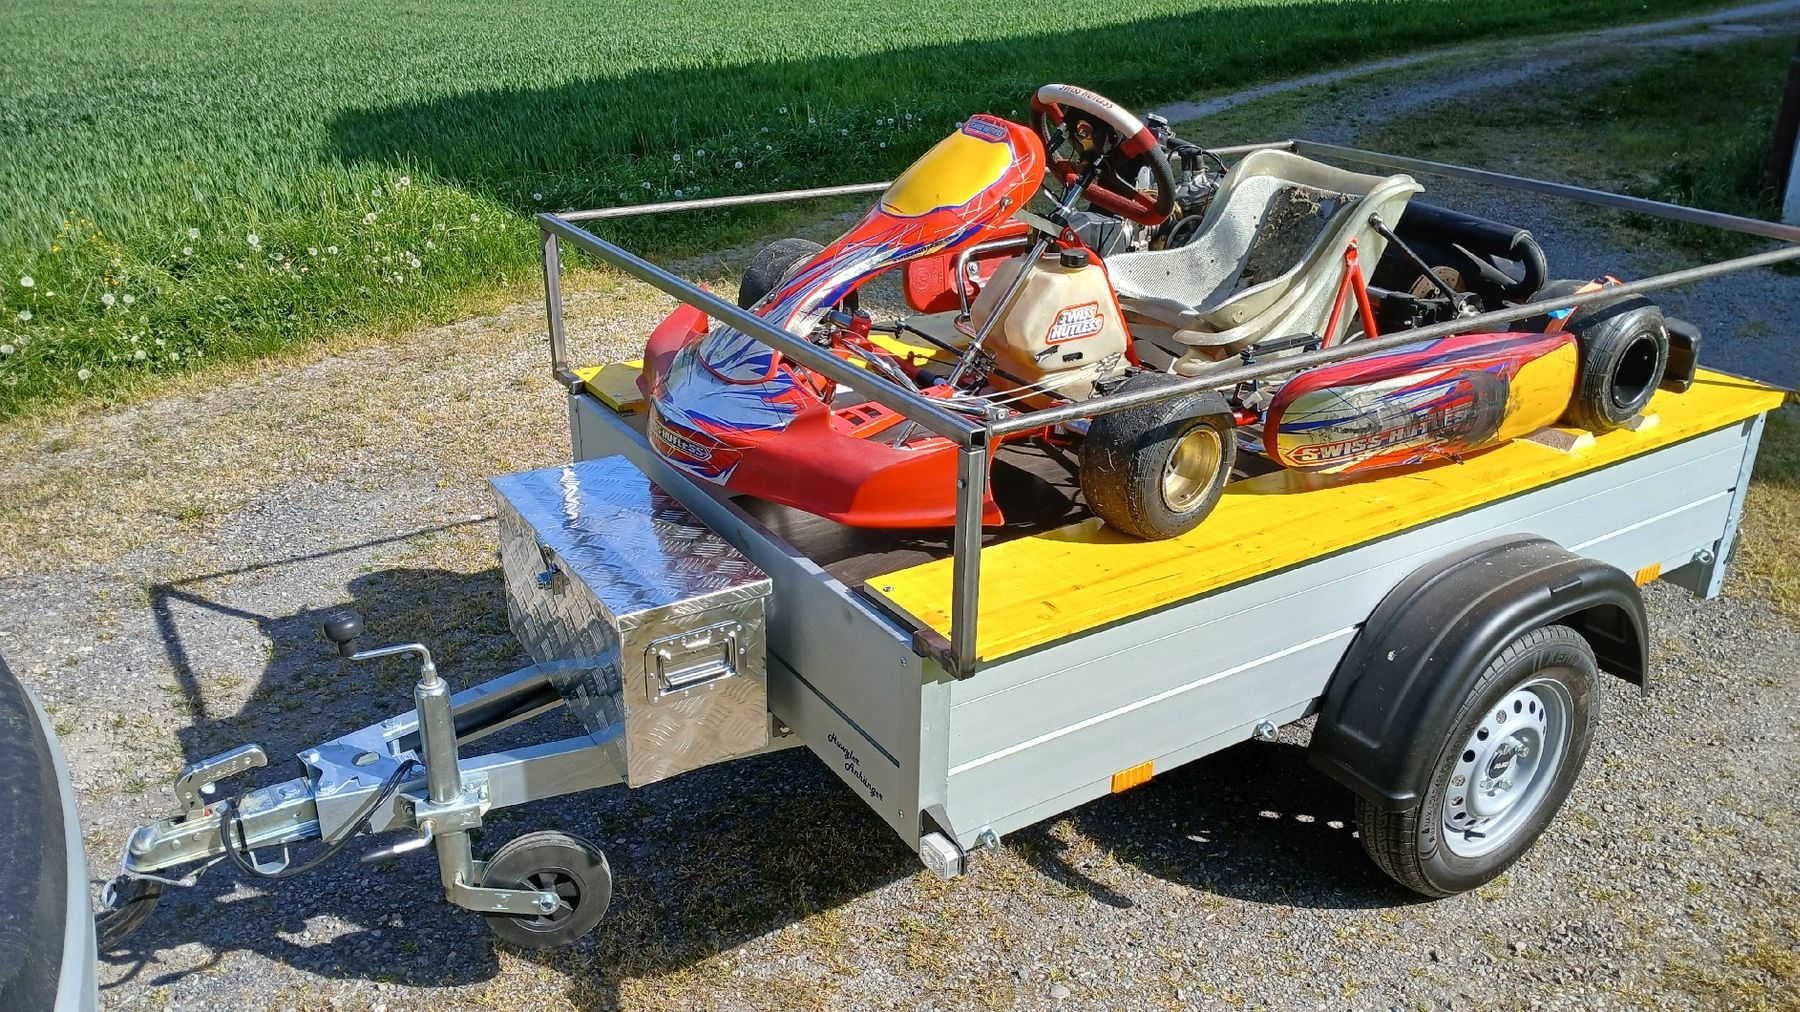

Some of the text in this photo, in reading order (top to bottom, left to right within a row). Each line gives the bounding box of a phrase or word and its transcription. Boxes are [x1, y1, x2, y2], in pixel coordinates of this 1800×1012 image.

[1049, 319, 1101, 340] HUTLESS
[1057, 307, 1096, 325] SWISS
[660, 429, 705, 458] HUTLESS
[1301, 434, 1384, 461] SWISS
[828, 733, 860, 766] Huwyler
[845, 763, 883, 801] Anhänger
